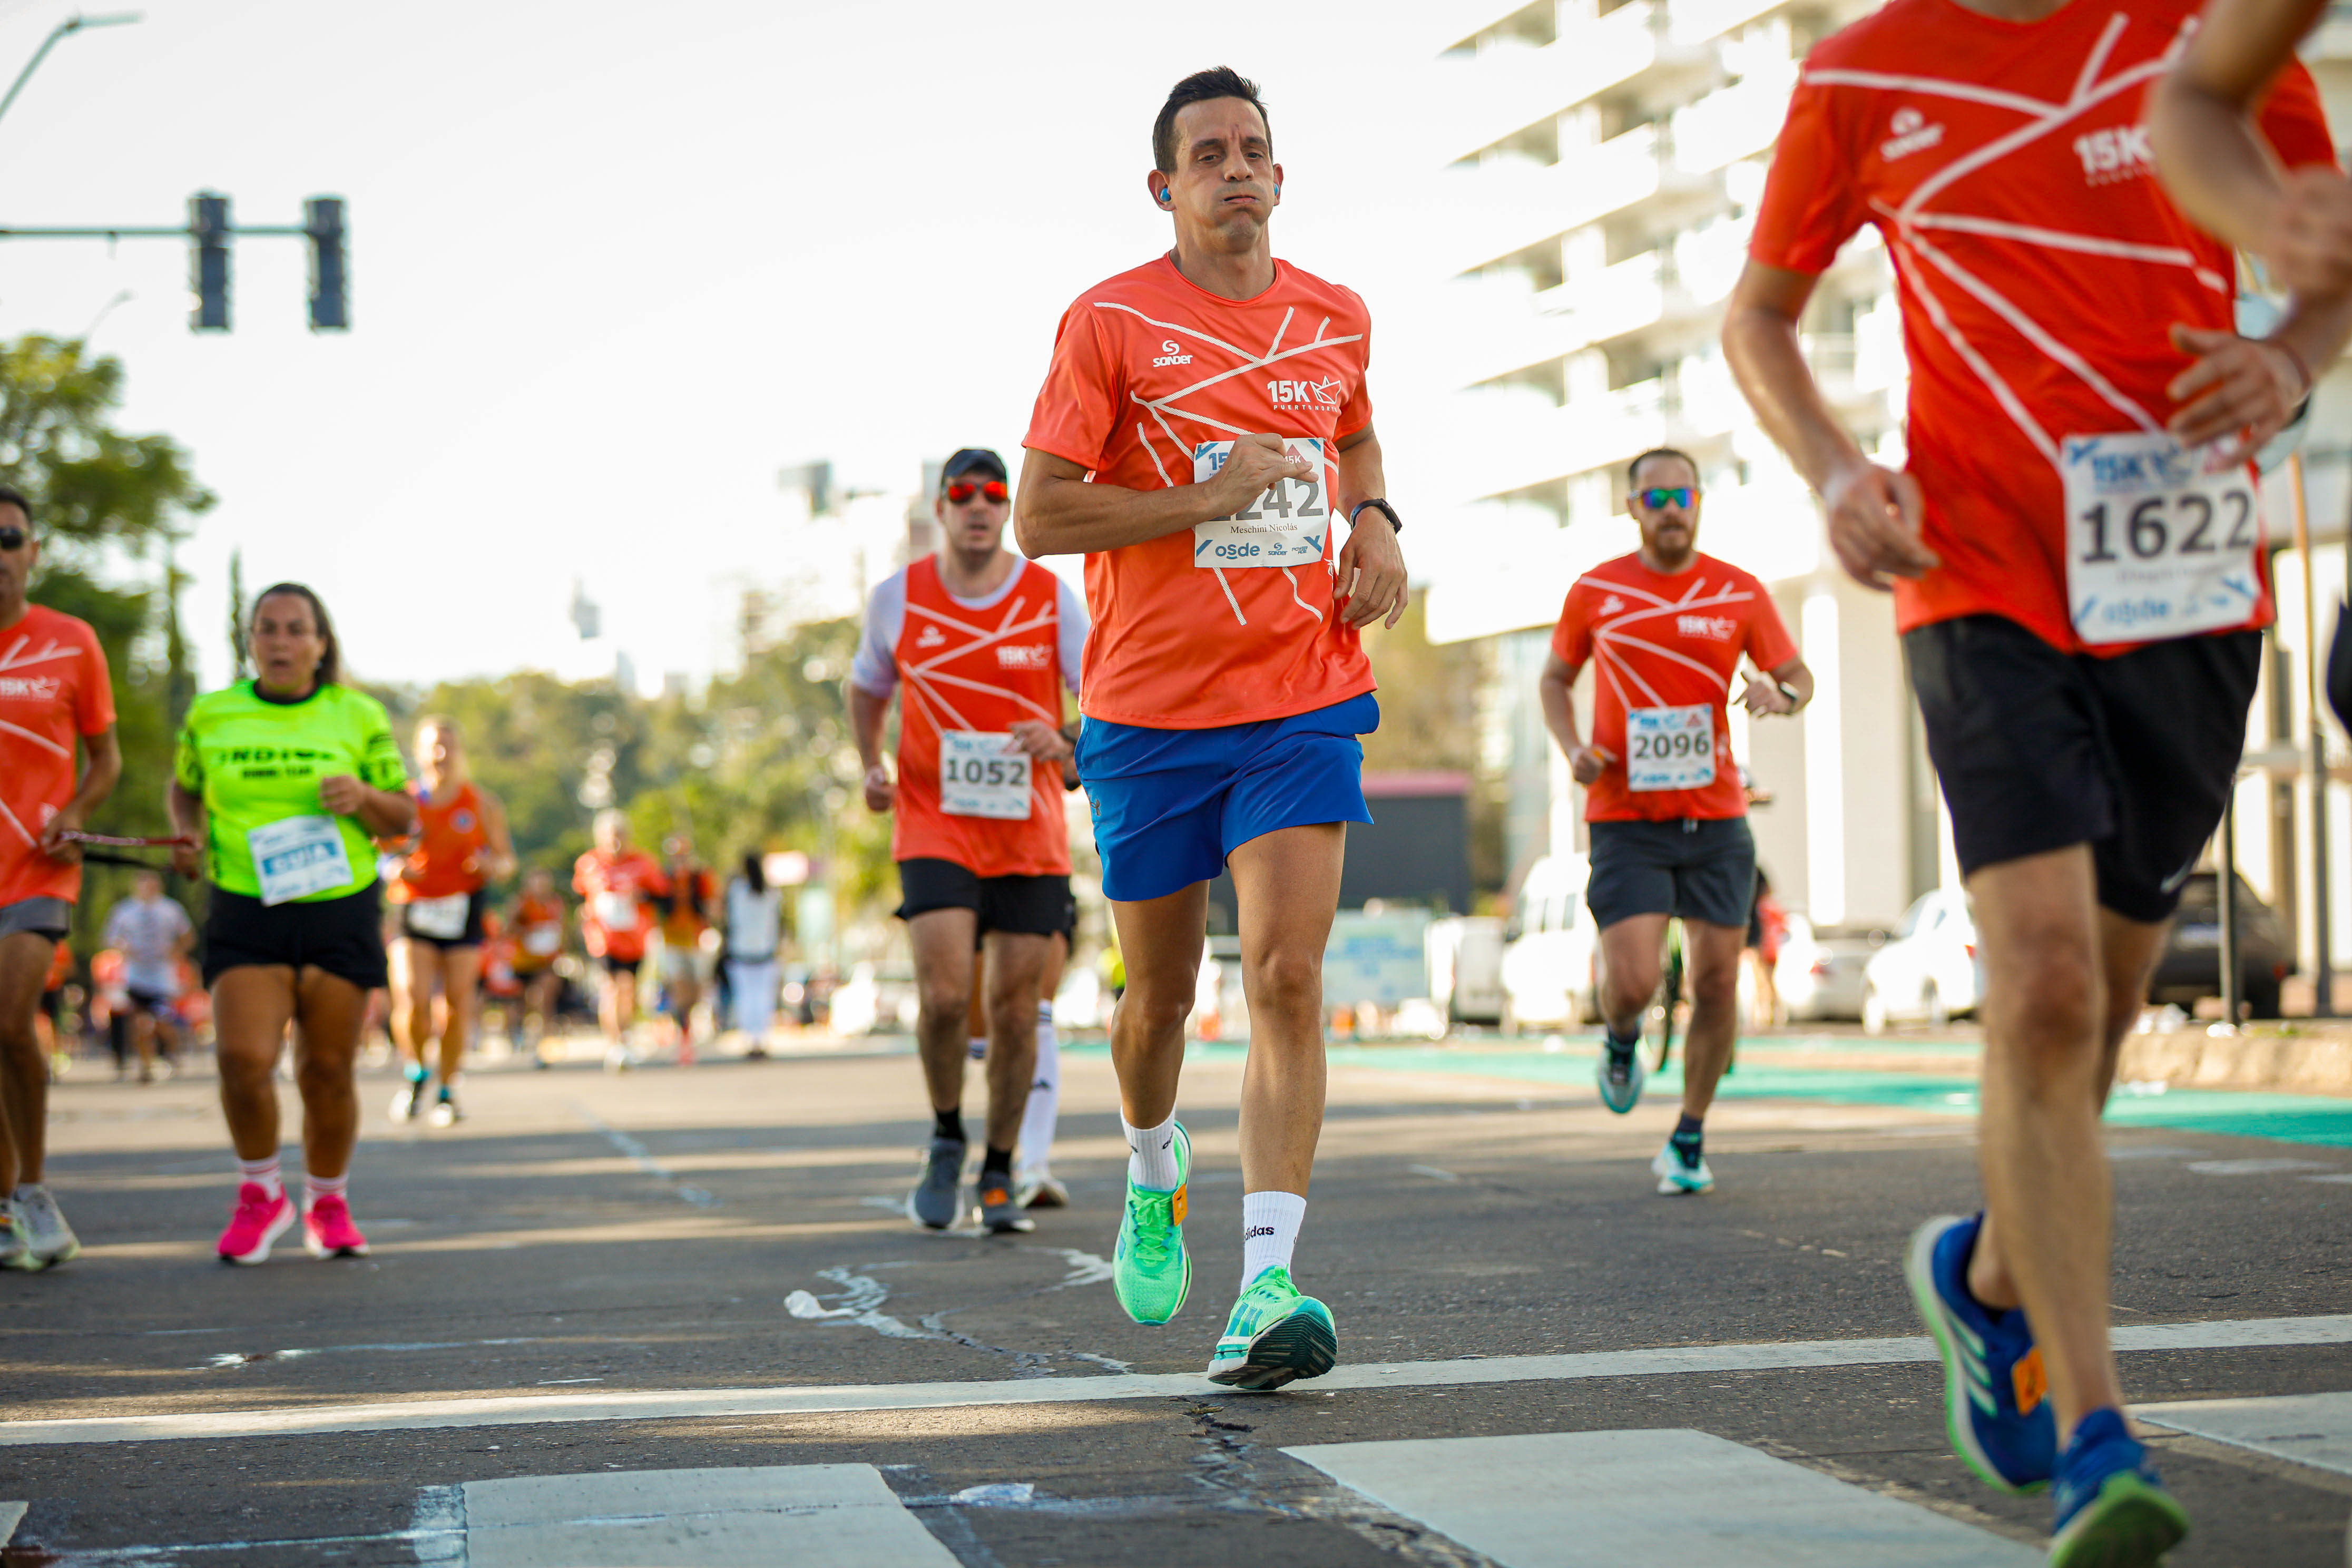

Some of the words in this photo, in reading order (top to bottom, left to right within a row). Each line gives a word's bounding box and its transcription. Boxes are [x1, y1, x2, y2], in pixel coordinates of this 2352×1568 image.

[2073, 125, 2153, 175] 15K
[1267, 380, 1311, 403] 15K
[1231, 525, 1267, 534] Meschini
[1269, 523, 1298, 533] Nicolás
[2079, 489, 2252, 563] 1622
[1215, 542, 1260, 558] osde
[1634, 730, 1709, 759] 2096
[947, 757, 1025, 786] 1052
[1244, 1225, 1275, 1241] didas
